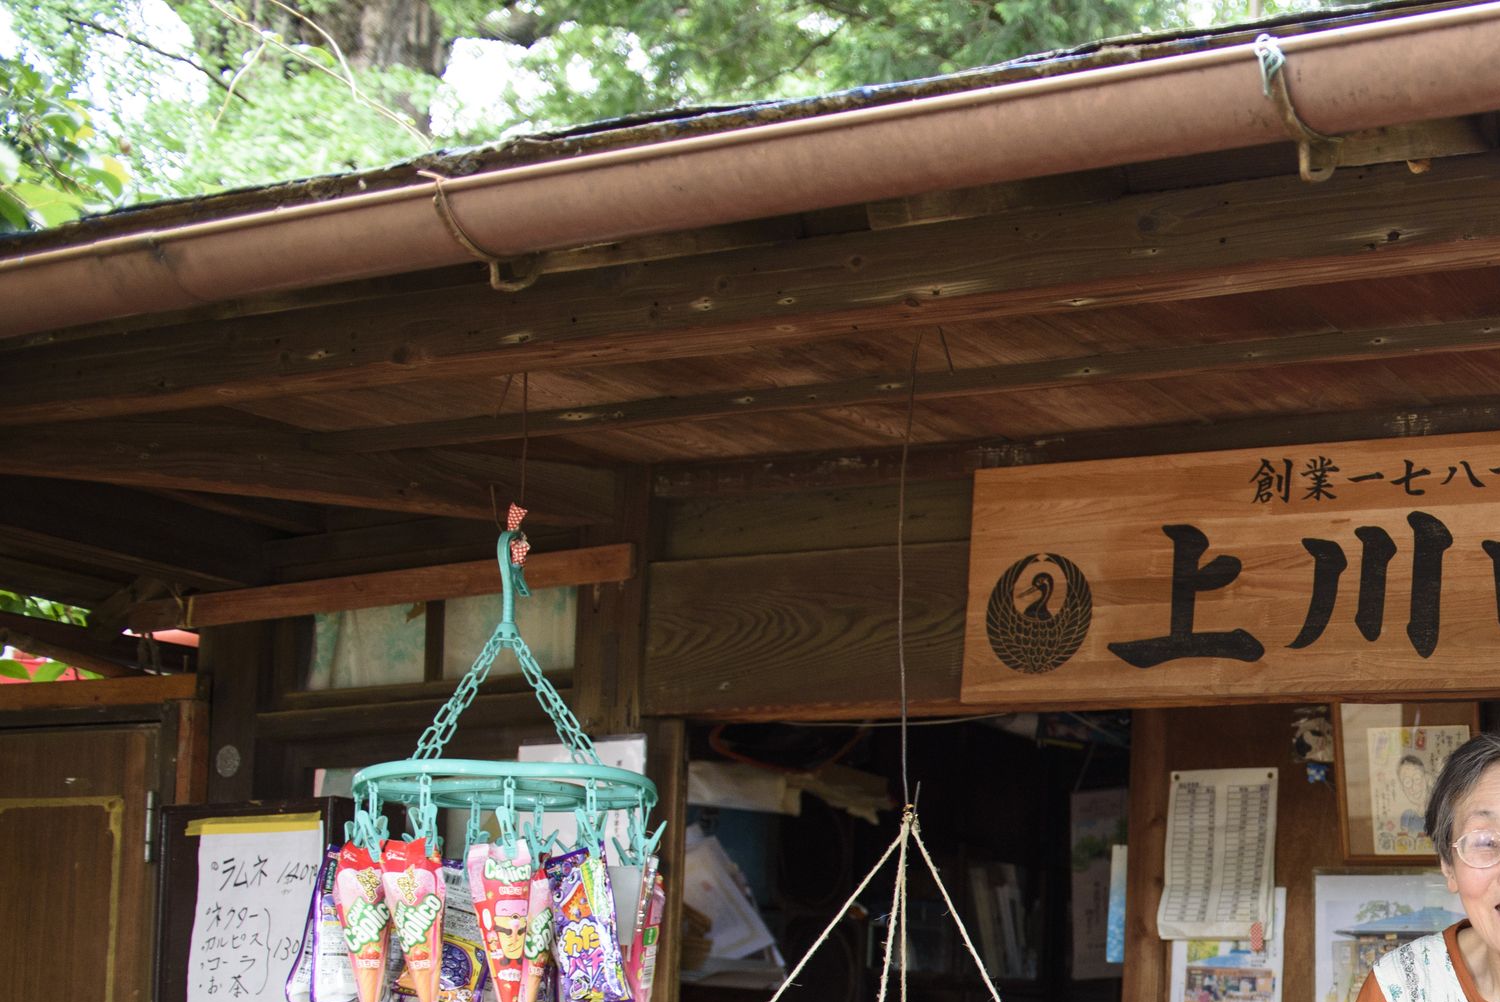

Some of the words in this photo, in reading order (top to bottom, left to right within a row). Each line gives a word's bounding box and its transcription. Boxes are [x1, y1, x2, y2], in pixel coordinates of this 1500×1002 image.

[219, 858, 268, 891] ラムネ
[563, 925, 601, 954] わた
